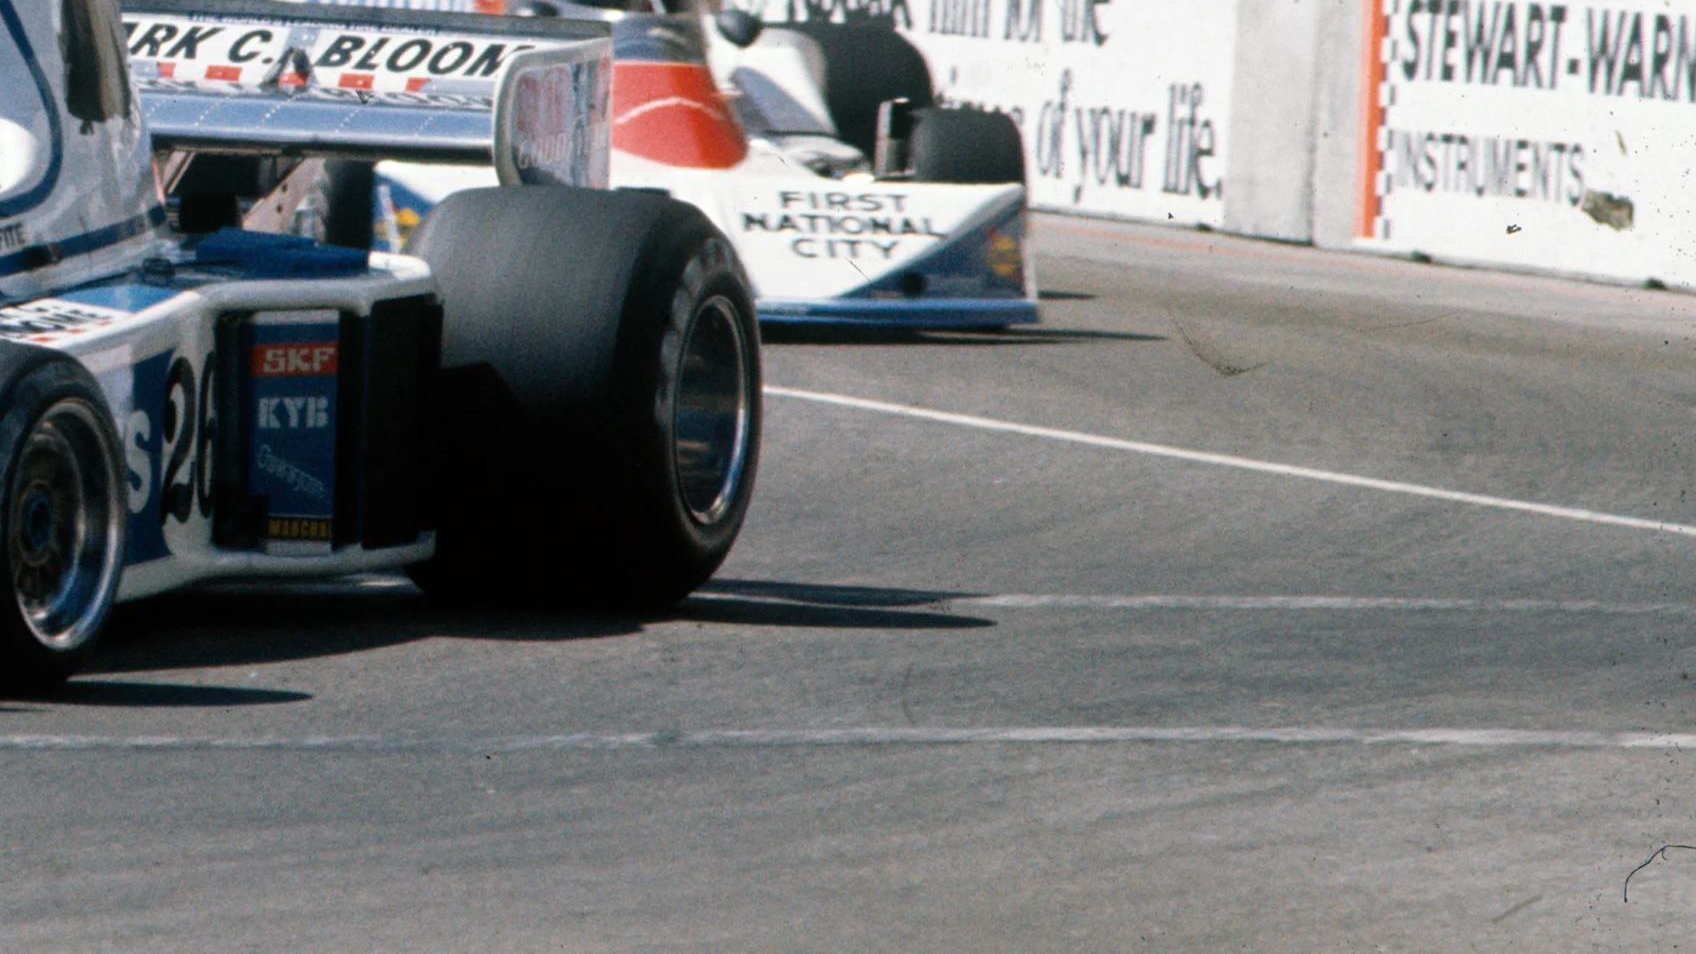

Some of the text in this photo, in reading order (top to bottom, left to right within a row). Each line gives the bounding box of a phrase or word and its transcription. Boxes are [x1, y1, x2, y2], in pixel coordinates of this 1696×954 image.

[228, 30, 274, 63] C.
[1036, 68, 1073, 179] of
[1074, 106, 1156, 202] your
[1162, 80, 1223, 201] life.
[1396, 133, 1586, 207] INSTRUMENTS
[780, 190, 908, 213] FIRST
[742, 212, 947, 238] NATIONAL
[791, 237, 901, 259] CITY
[263, 347, 336, 373] SKF
[257, 396, 329, 429] KYB
